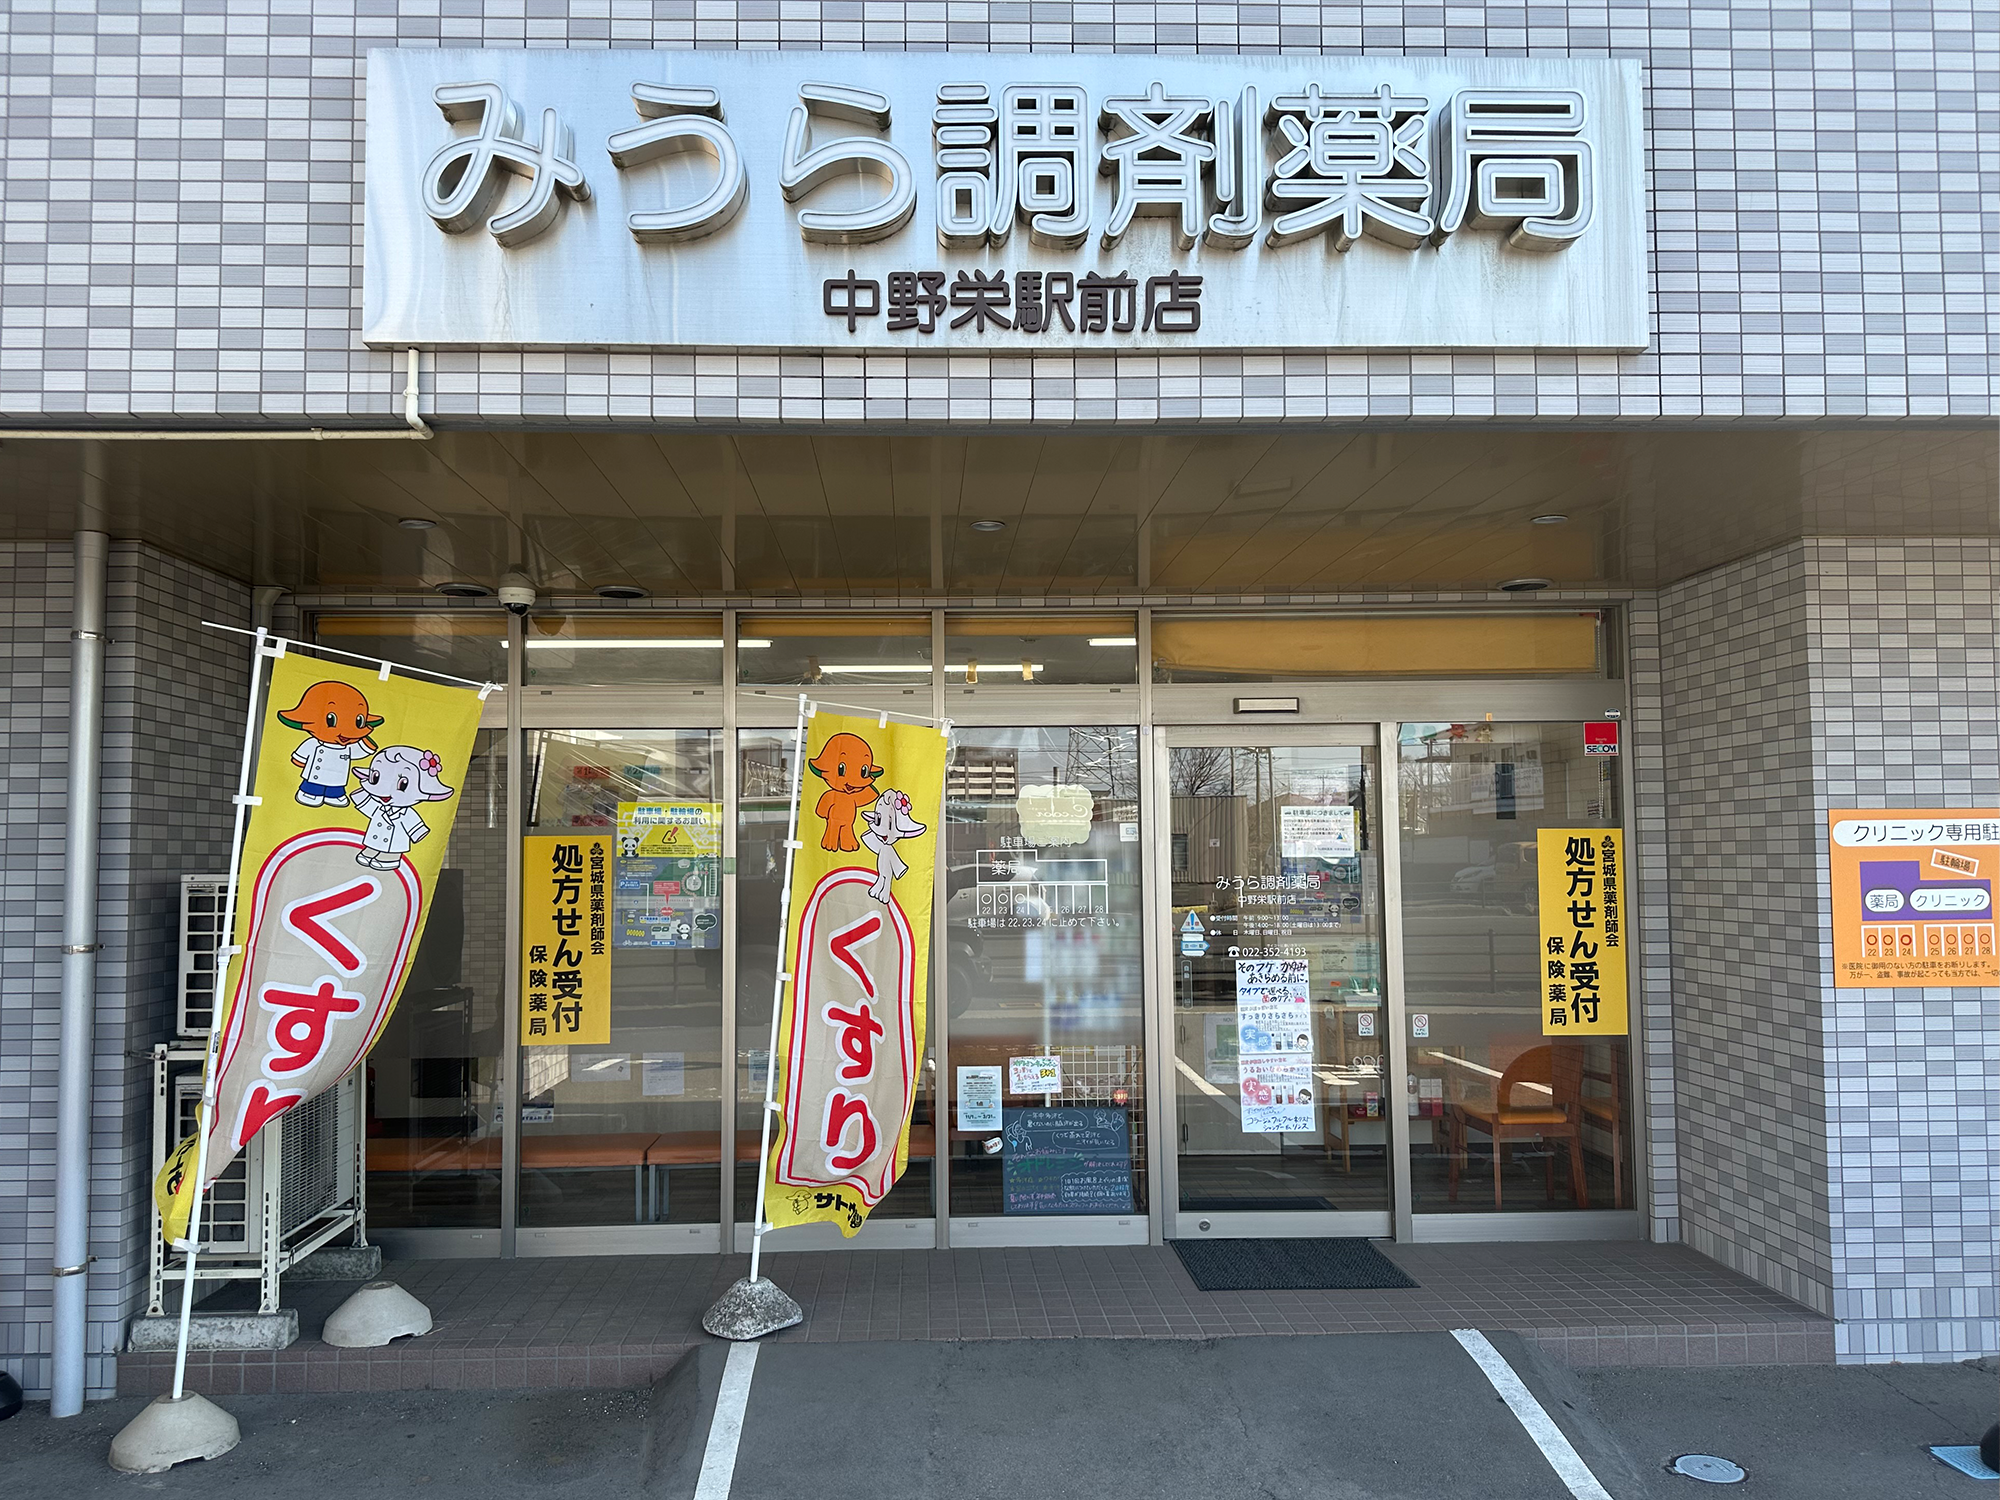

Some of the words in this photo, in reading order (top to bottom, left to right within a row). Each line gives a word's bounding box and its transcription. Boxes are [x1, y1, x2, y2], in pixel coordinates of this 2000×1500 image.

[421, 80, 1597, 247] みうら調剤薬局
[823, 269, 1202, 334] 中野栄駅前店
[1586, 745, 1617, 753] SECOM
[634, 816, 707, 825] 利用に関するお願い
[1853, 823, 2000, 842] クリニック専用駐
[992, 860, 1021, 876] 薬局
[1939, 854, 1971, 872] 駐輪場
[1216, 875, 1321, 890] みうら調剤薬局
[590, 855, 605, 955] 宮城県薬剤師会
[1238, 894, 1297, 905] 中野栄駅前店
[1601, 849, 1619, 948] 宮城県薬剤師会
[1869, 894, 1899, 909] 薬局
[1916, 894, 1985, 908] クリニック
[982, 906, 991, 914] 22
[998, 906, 1008, 914] 23
[1015, 906, 1025, 914] 24
[1060, 906, 1070, 914] 26
[1078, 906, 1087, 914] 27
[1094, 906, 1104, 914] 28
[551, 843, 583, 1033] 処方せん受付
[1565, 836, 1600, 1024] 処方せん受付
[1242, 948, 1307, 957] 022-352-4193
[1867, 949, 1877, 957] 22
[1884, 948, 1894, 956] 23
[1902, 948, 1911, 956] 24
[1930, 947, 1940, 956] 25
[1947, 947, 1957, 955] 26
[1964, 947, 1974, 955] 27
[1981, 946, 1991, 954] 28
[1547, 936, 1567, 1026] 保険薬局
[1849, 969, 2000, 979] 万が一、盗難、事故が起こっても当方では、一切
[528, 945, 548, 1036] 保険薬局
[826, 916, 884, 1170] くすり
